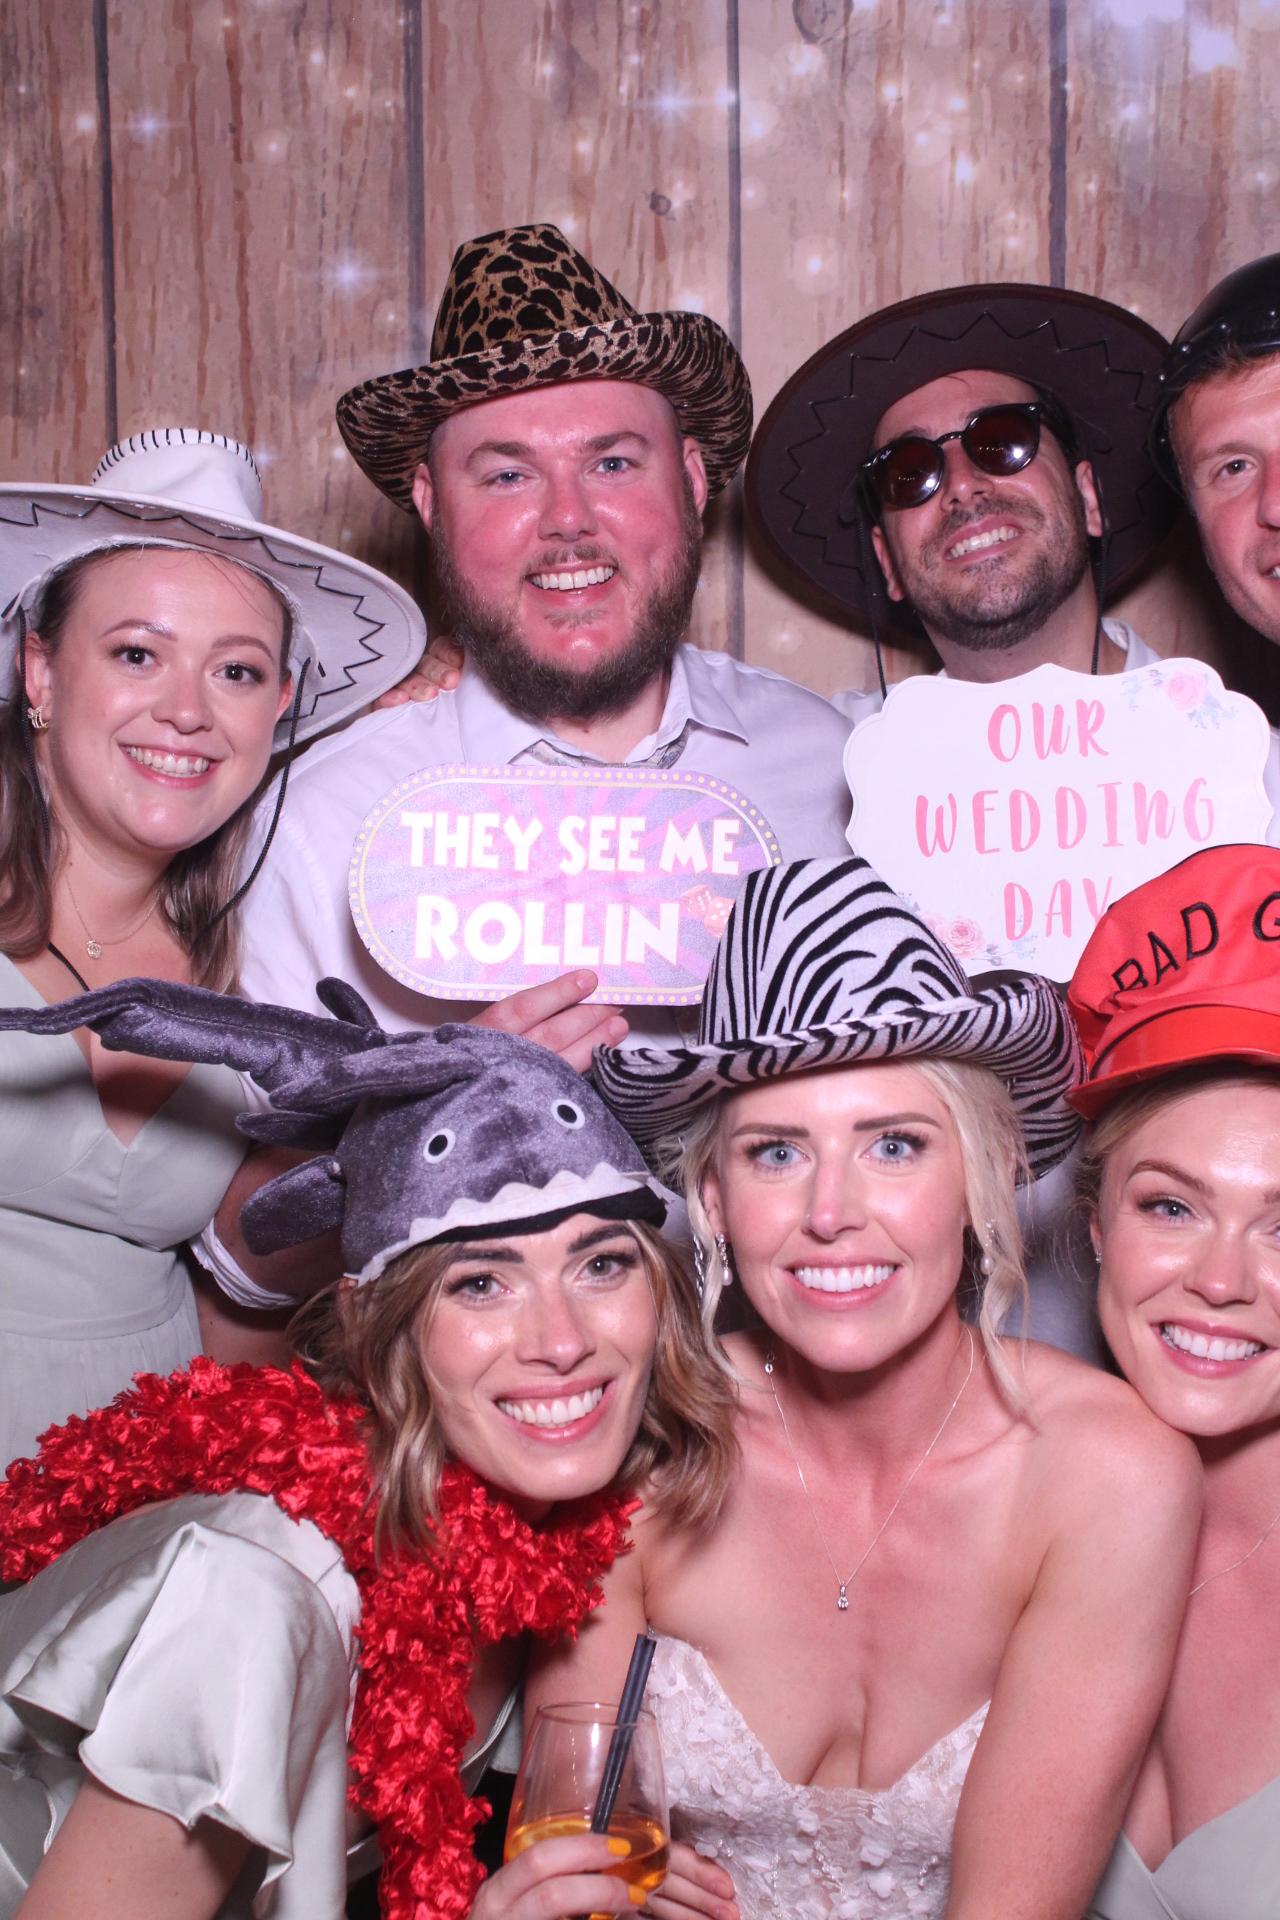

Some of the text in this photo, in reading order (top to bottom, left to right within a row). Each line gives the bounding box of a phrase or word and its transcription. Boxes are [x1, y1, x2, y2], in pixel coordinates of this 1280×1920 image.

[987, 698, 1110, 763] OUR
[400, 811, 741, 876] THEY SEE ME
[914, 777, 1216, 858] WEDDING
[413, 895, 680, 966] ROLLIN
[1003, 876, 1113, 941] DAY
[1111, 901, 1220, 988] BAD
